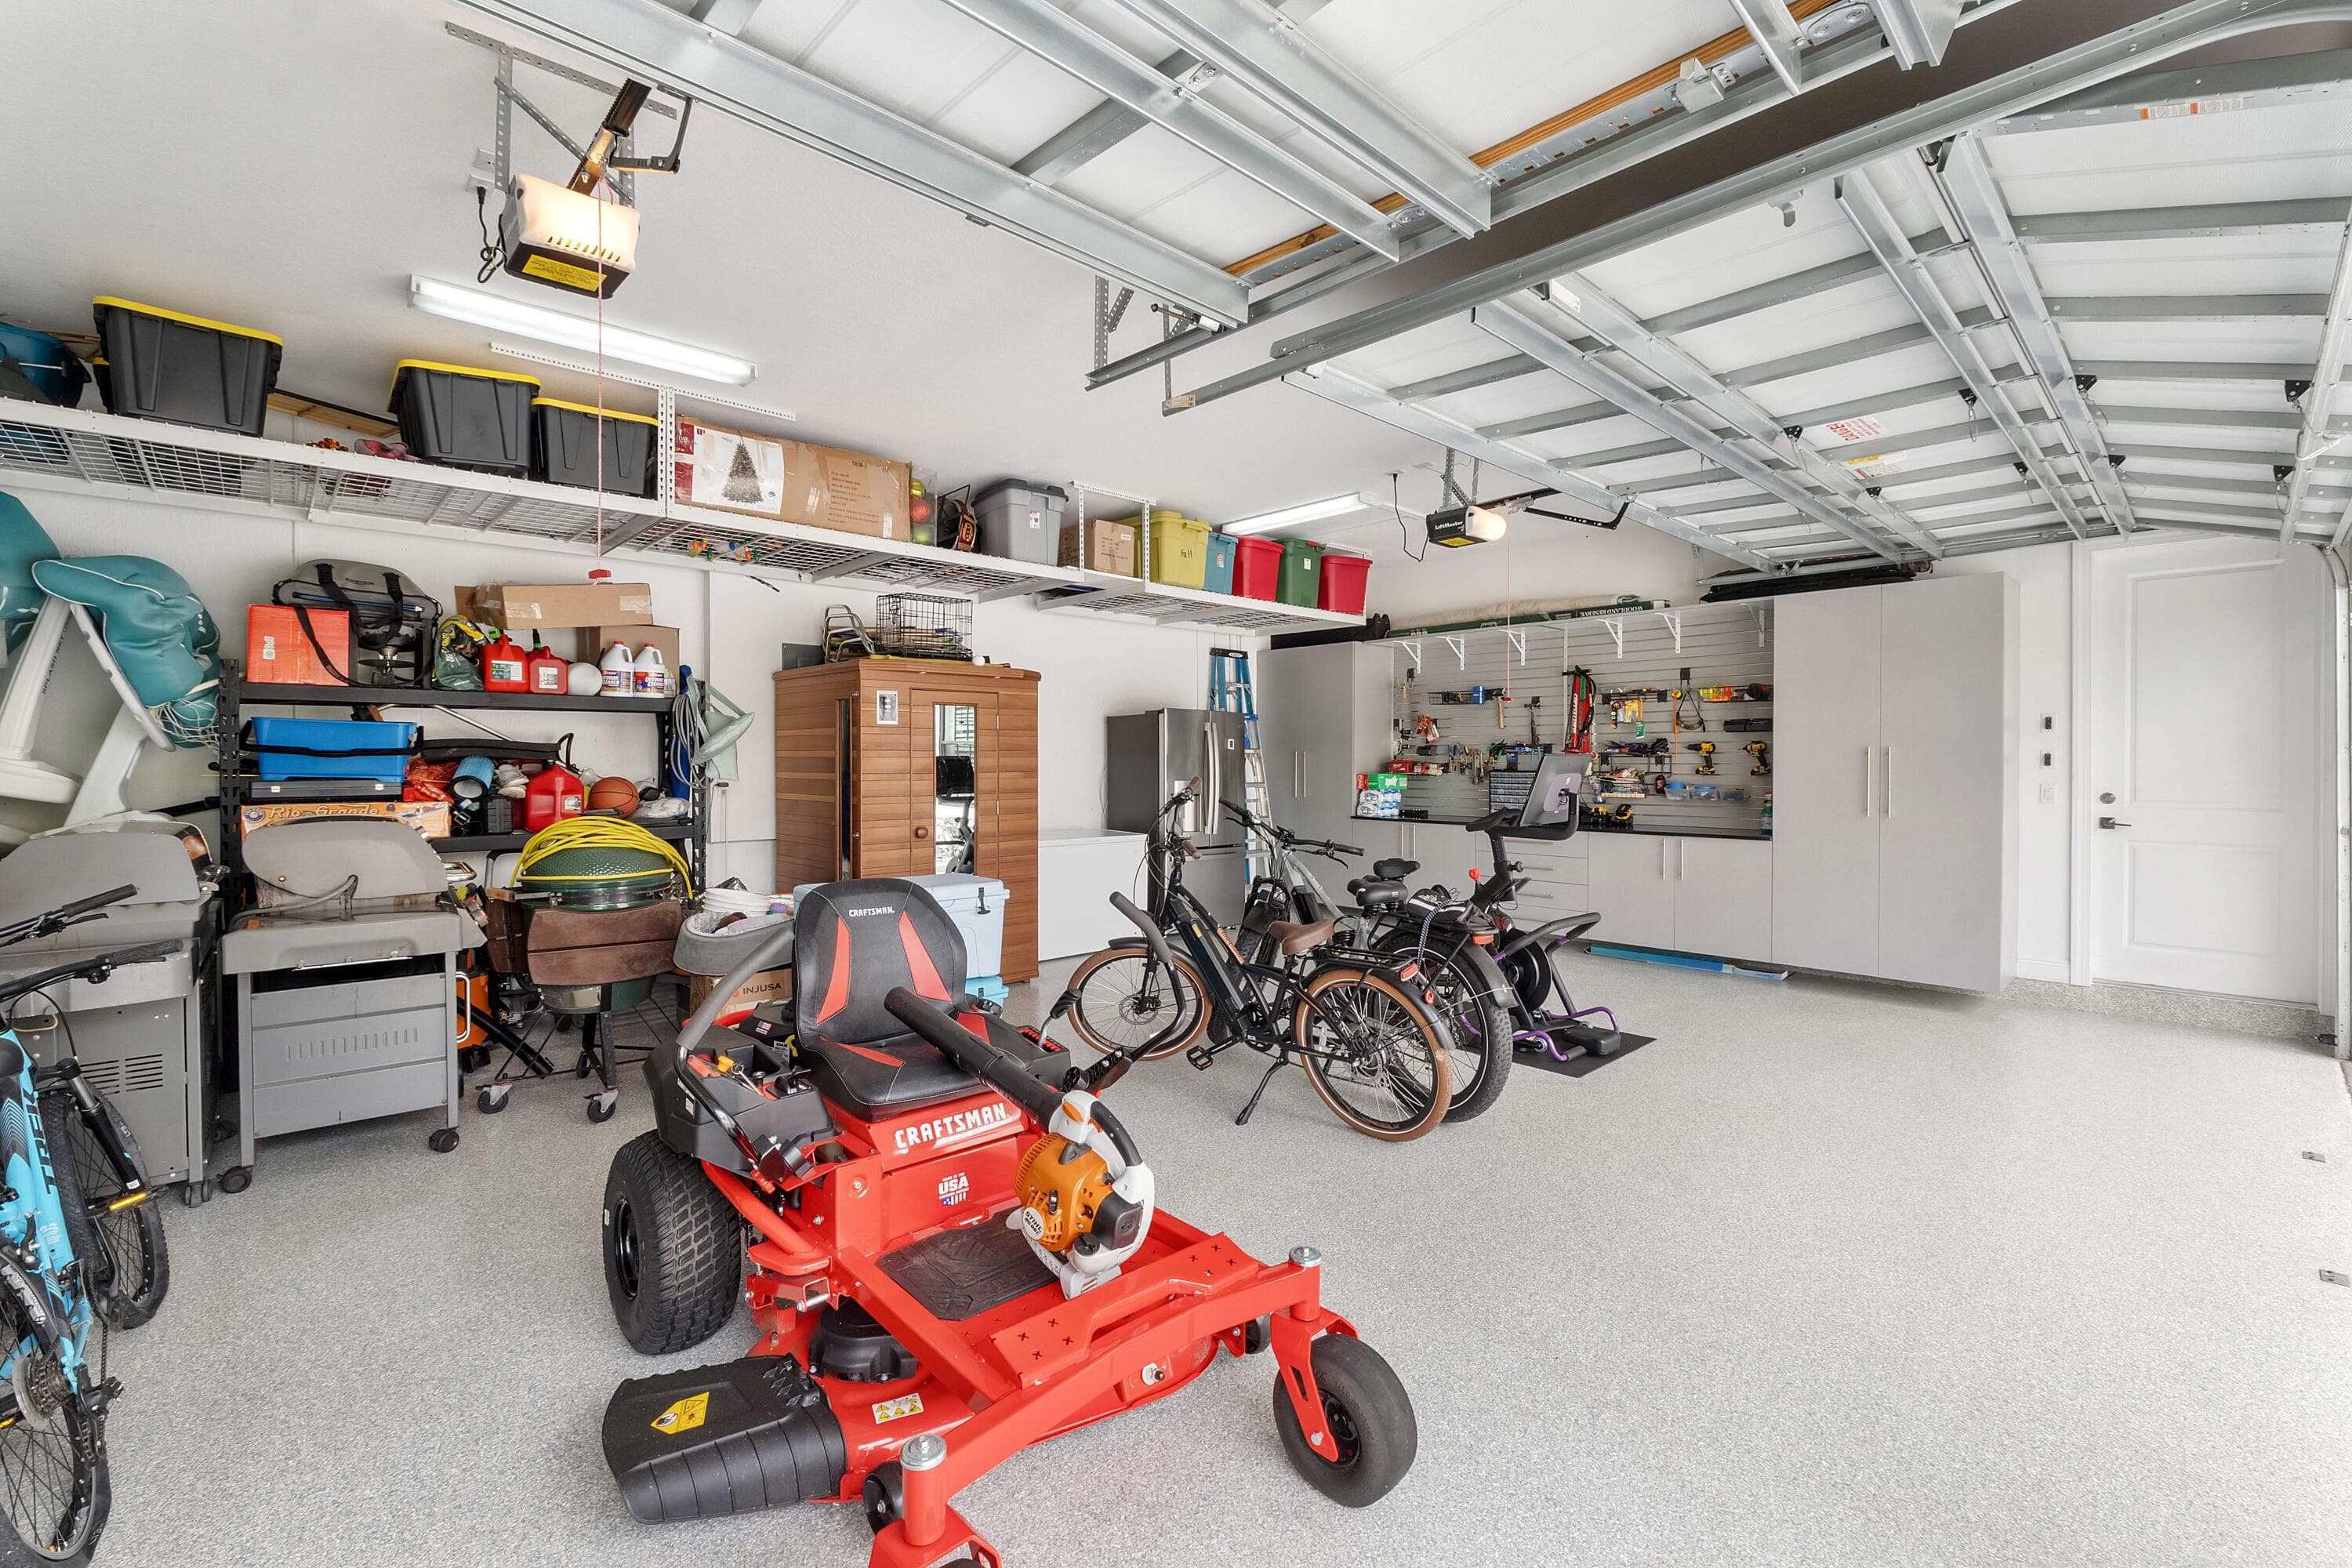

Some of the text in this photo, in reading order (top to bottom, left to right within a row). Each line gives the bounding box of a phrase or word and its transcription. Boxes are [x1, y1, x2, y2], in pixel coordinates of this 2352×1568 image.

[1435, 521, 1464, 530] LiftMaster
[1181, 549, 1192, 559] Fall
[269, 807, 302, 819] Rio
[742, 982, 782, 995] INJUSA
[23, 1090, 58, 1195] TREK
[938, 1175, 970, 1195] USA
[1024, 1210, 1043, 1233] STIHL
